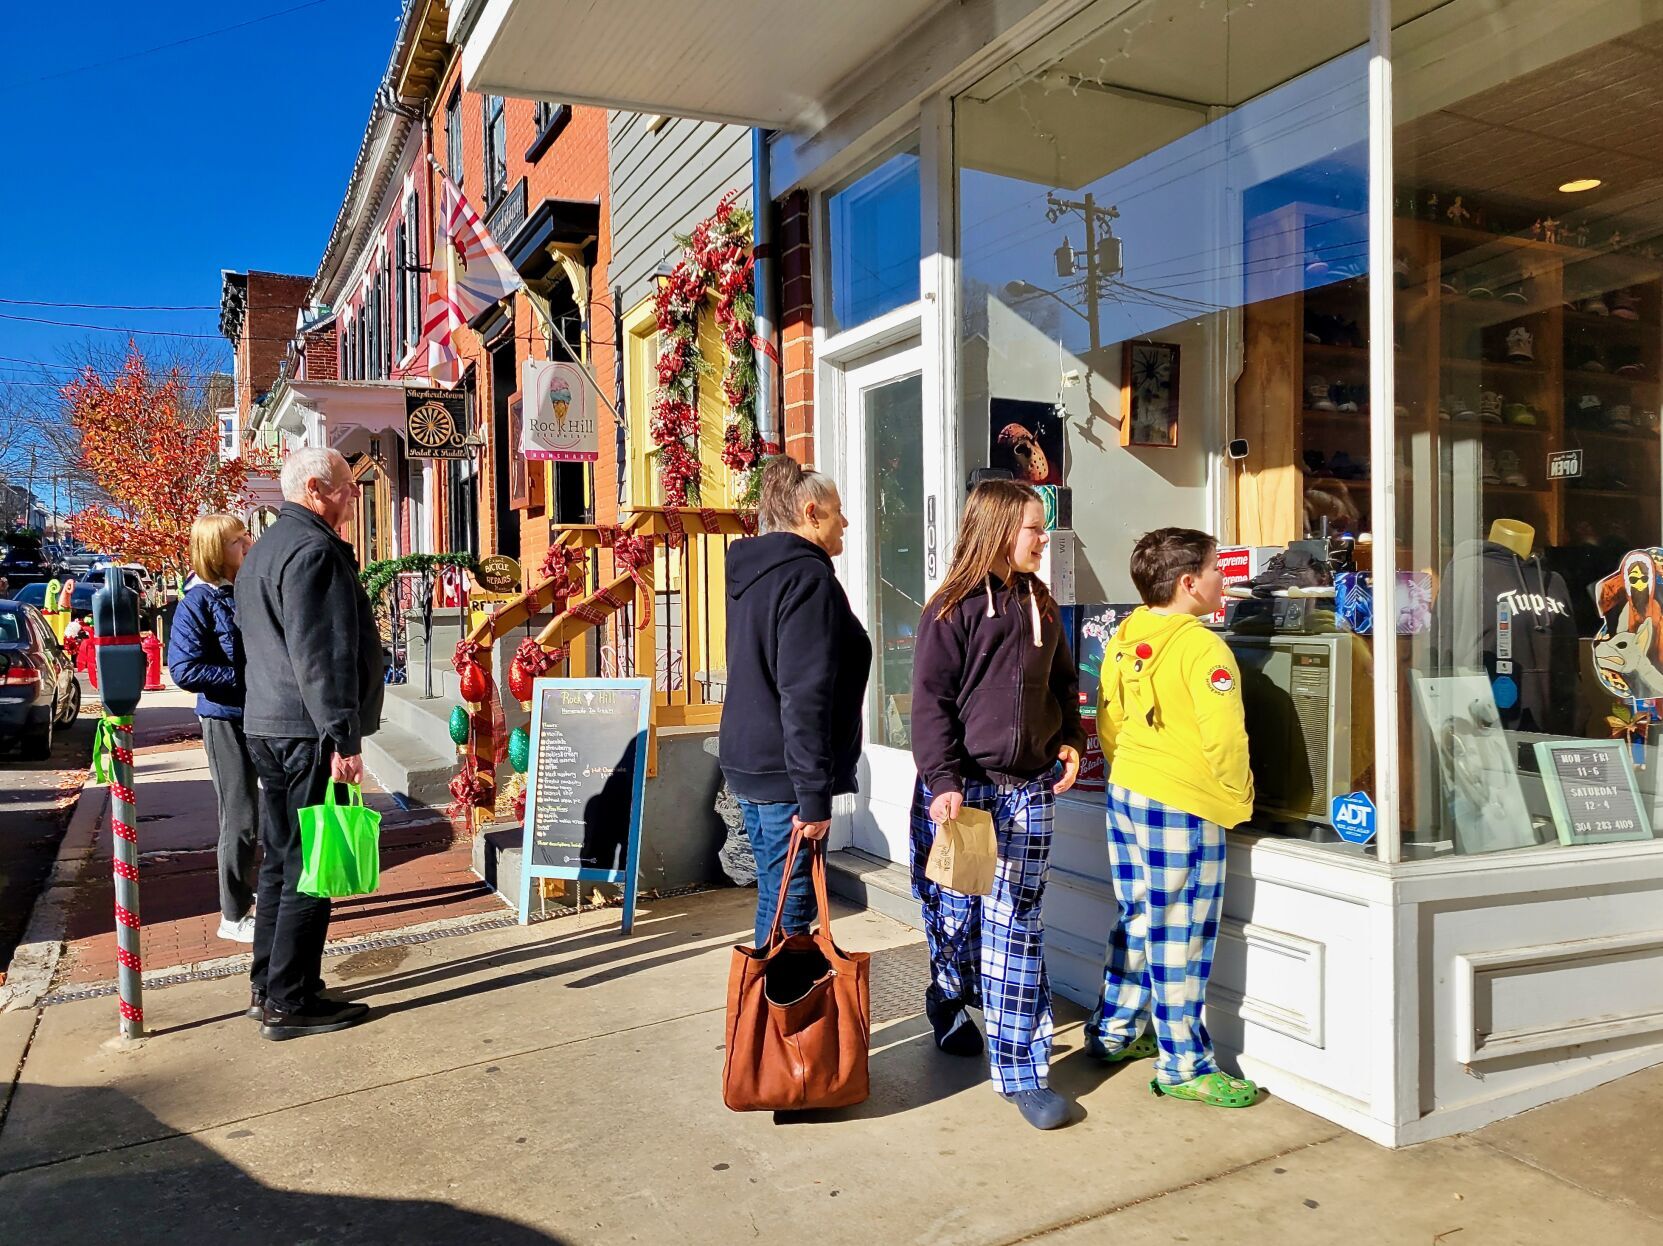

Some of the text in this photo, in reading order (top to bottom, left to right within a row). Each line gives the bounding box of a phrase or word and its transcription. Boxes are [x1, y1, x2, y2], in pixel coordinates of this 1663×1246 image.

[407, 389, 464, 400] Shepherdstown
[529, 419, 594, 433] Rock Hill
[928, 497, 936, 578] 109
[485, 563, 510, 573] BICYCLE
[486, 575, 512, 585] REPAIRS
[1497, 589, 1570, 616] Tupac
[562, 691, 582, 705] Rock
[1561, 754, 1581, 763] MON
[1593, 752, 1609, 763] FRI
[1570, 787, 1618, 798] SATURDAY
[1335, 803, 1372, 827] ADT
[1575, 822, 1592, 832] 304
[1614, 820, 1634, 830] 4109
